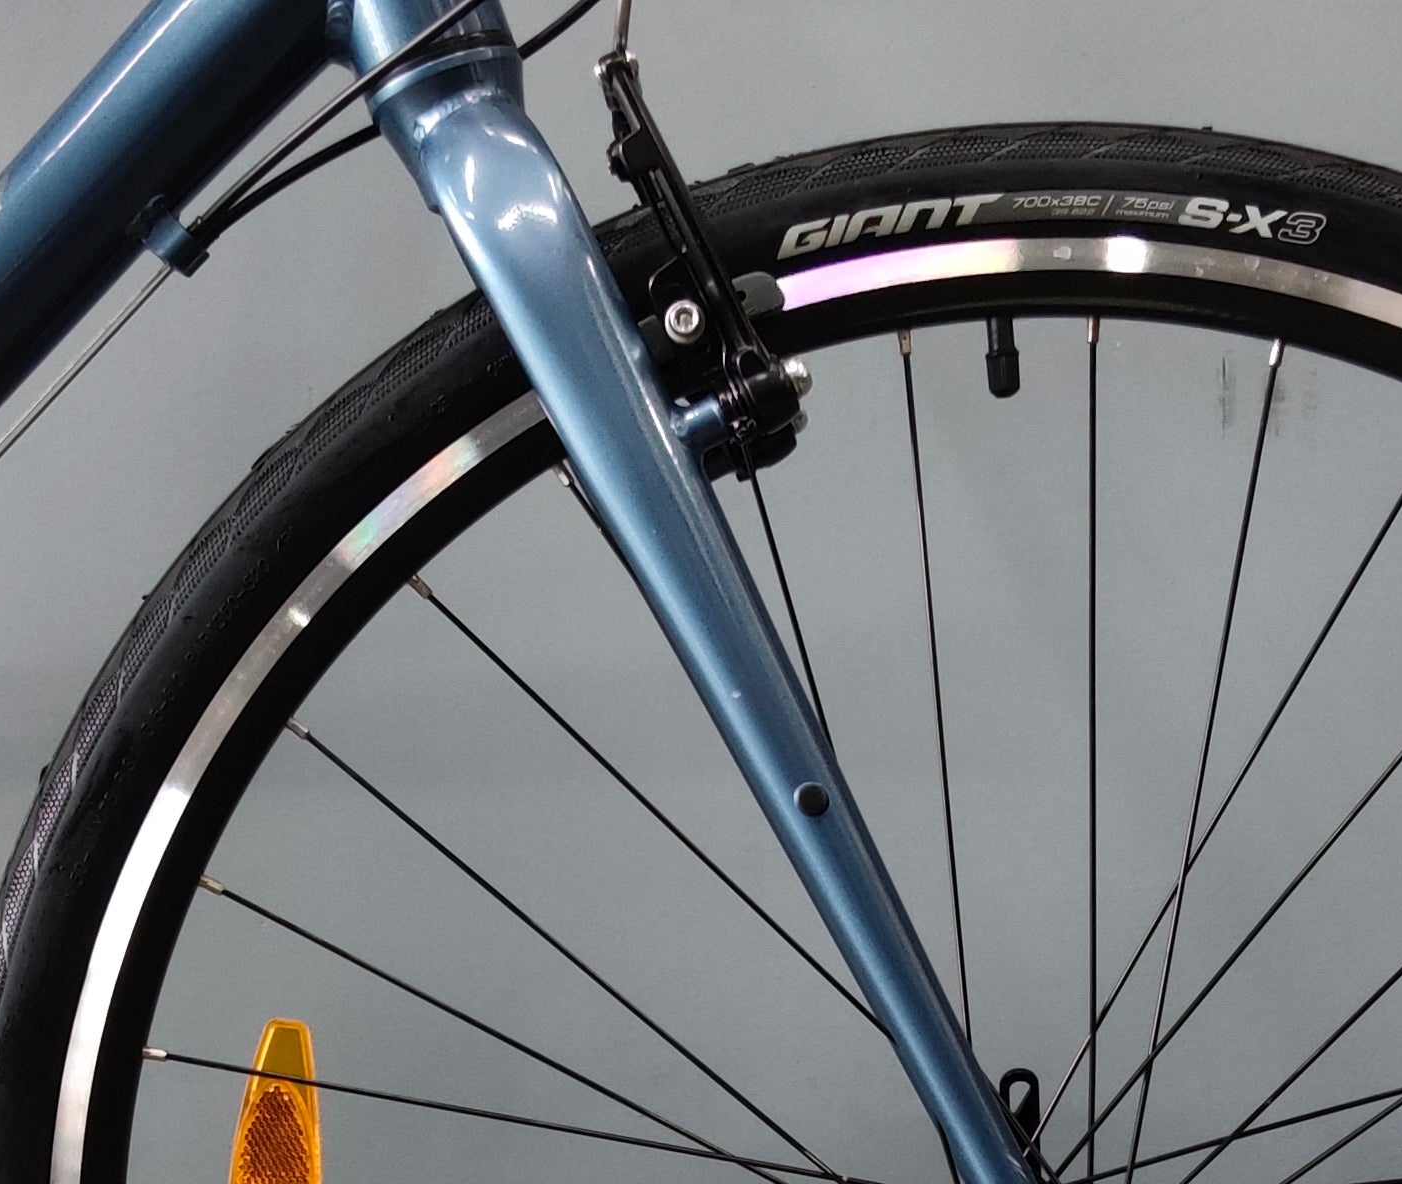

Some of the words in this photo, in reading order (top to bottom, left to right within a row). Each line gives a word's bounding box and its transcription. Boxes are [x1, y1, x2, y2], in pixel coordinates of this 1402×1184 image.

[1012, 195, 1102, 209] 700x38C
[1122, 197, 1176, 211] 75psi
[1115, 209, 1170, 219] maximum
[777, 194, 1003, 259] GIANT
